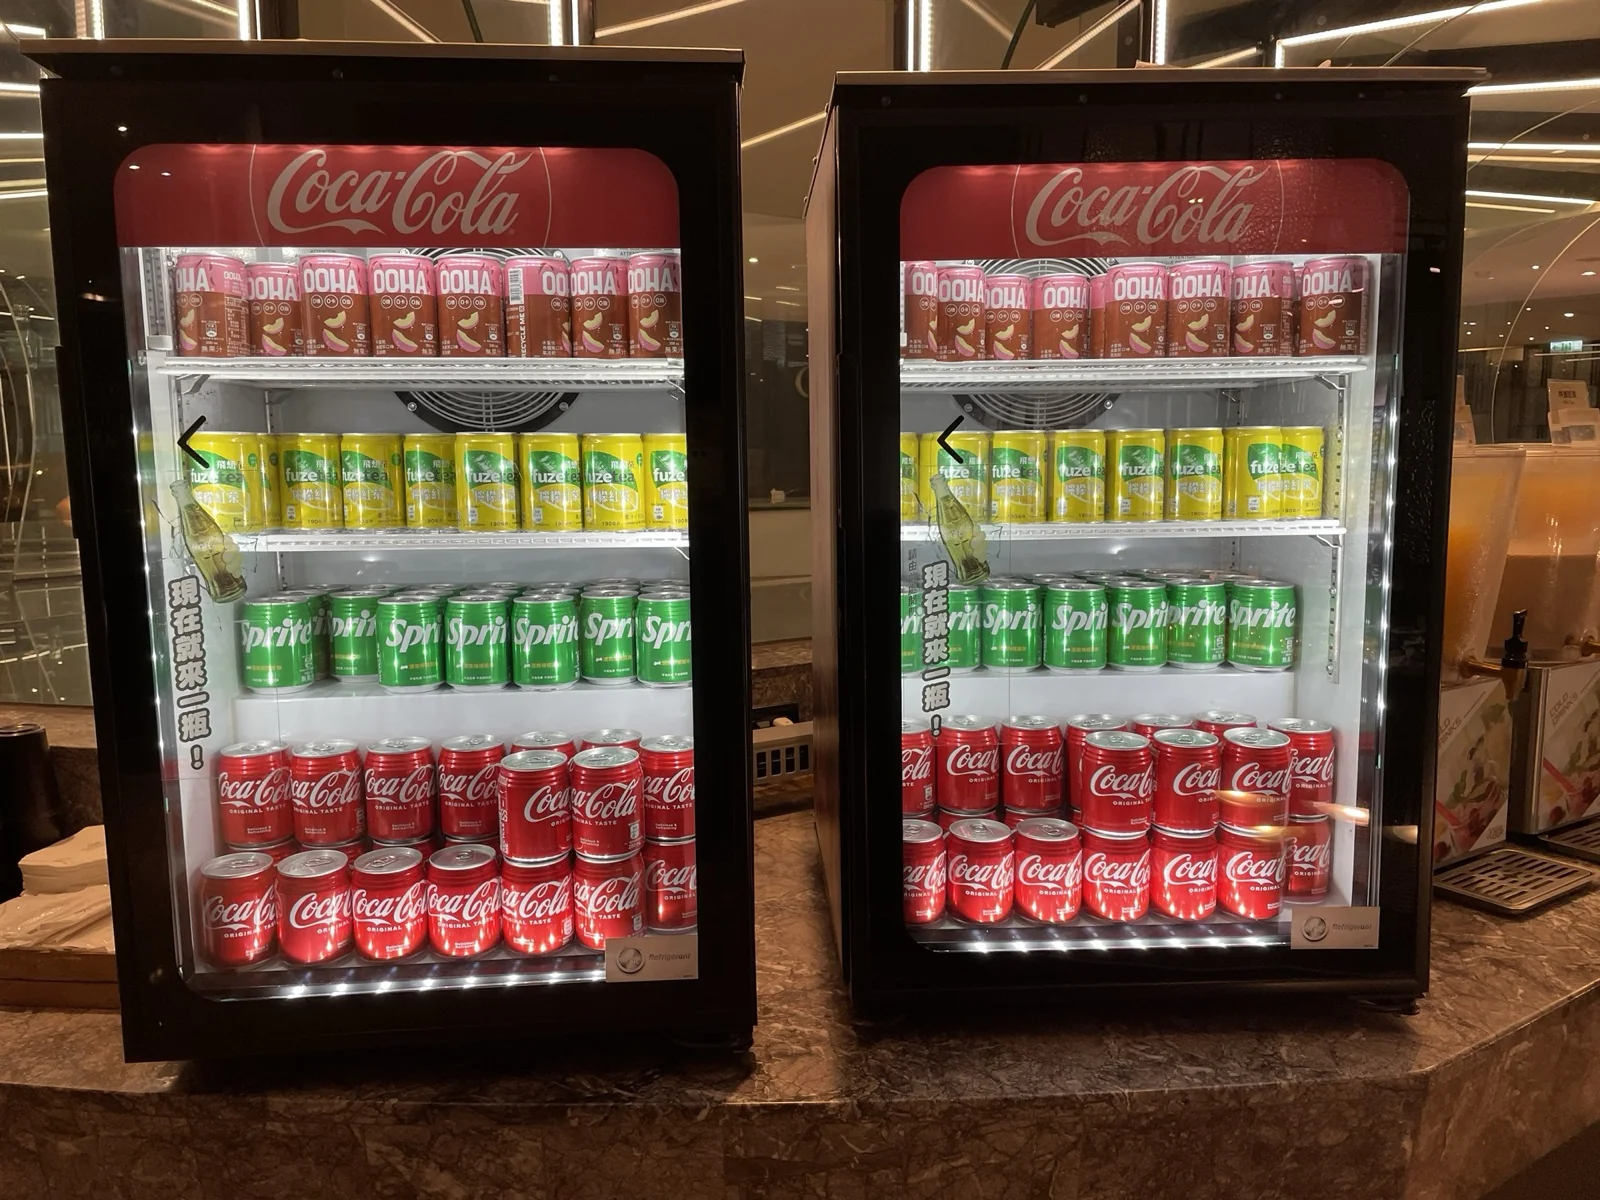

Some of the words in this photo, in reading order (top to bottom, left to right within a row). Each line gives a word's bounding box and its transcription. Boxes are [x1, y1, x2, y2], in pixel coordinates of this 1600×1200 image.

[267, 149, 532, 236] Coca-Cola
[1025, 165, 1270, 247] Coca-Cola
[303, 268, 359, 293] OOHA
[373, 269, 428, 293] OOHA
[440, 269, 492, 294] OOHA
[542, 271, 568, 296] OO
[912, 271, 937, 296] OO
[1114, 277, 1163, 300] OOHA
[1173, 275, 1224, 300] OOHA
[1234, 275, 1271, 300] OHA
[1302, 270, 1352, 295] OOHA
[191, 469, 218, 483] fuze
[285, 469, 318, 482] fuze
[365, 470, 388, 482] tea
[407, 468, 435, 482] fuze
[532, 469, 564, 483] fuze
[614, 470, 634, 482] tea
[653, 468, 685, 483] fuze
[939, 465, 969, 479] fuze
[992, 465, 1020, 479] fuze
[1058, 465, 1090, 479] fuze
[1122, 461, 1154, 475] fuze
[1171, 461, 1204, 476] fuze
[1250, 460, 1279, 474] fuze
[1298, 460, 1317, 473] tea
[468, 470, 500, 483] fuze
[1168, 599, 1225, 627] prite
[1230, 599, 1296, 631] Sprite
[386, 614, 443, 653] Spri
[446, 615, 507, 652] Sprit
[514, 615, 578, 652] Sprit
[648, 953, 691, 961] Refrigerant
